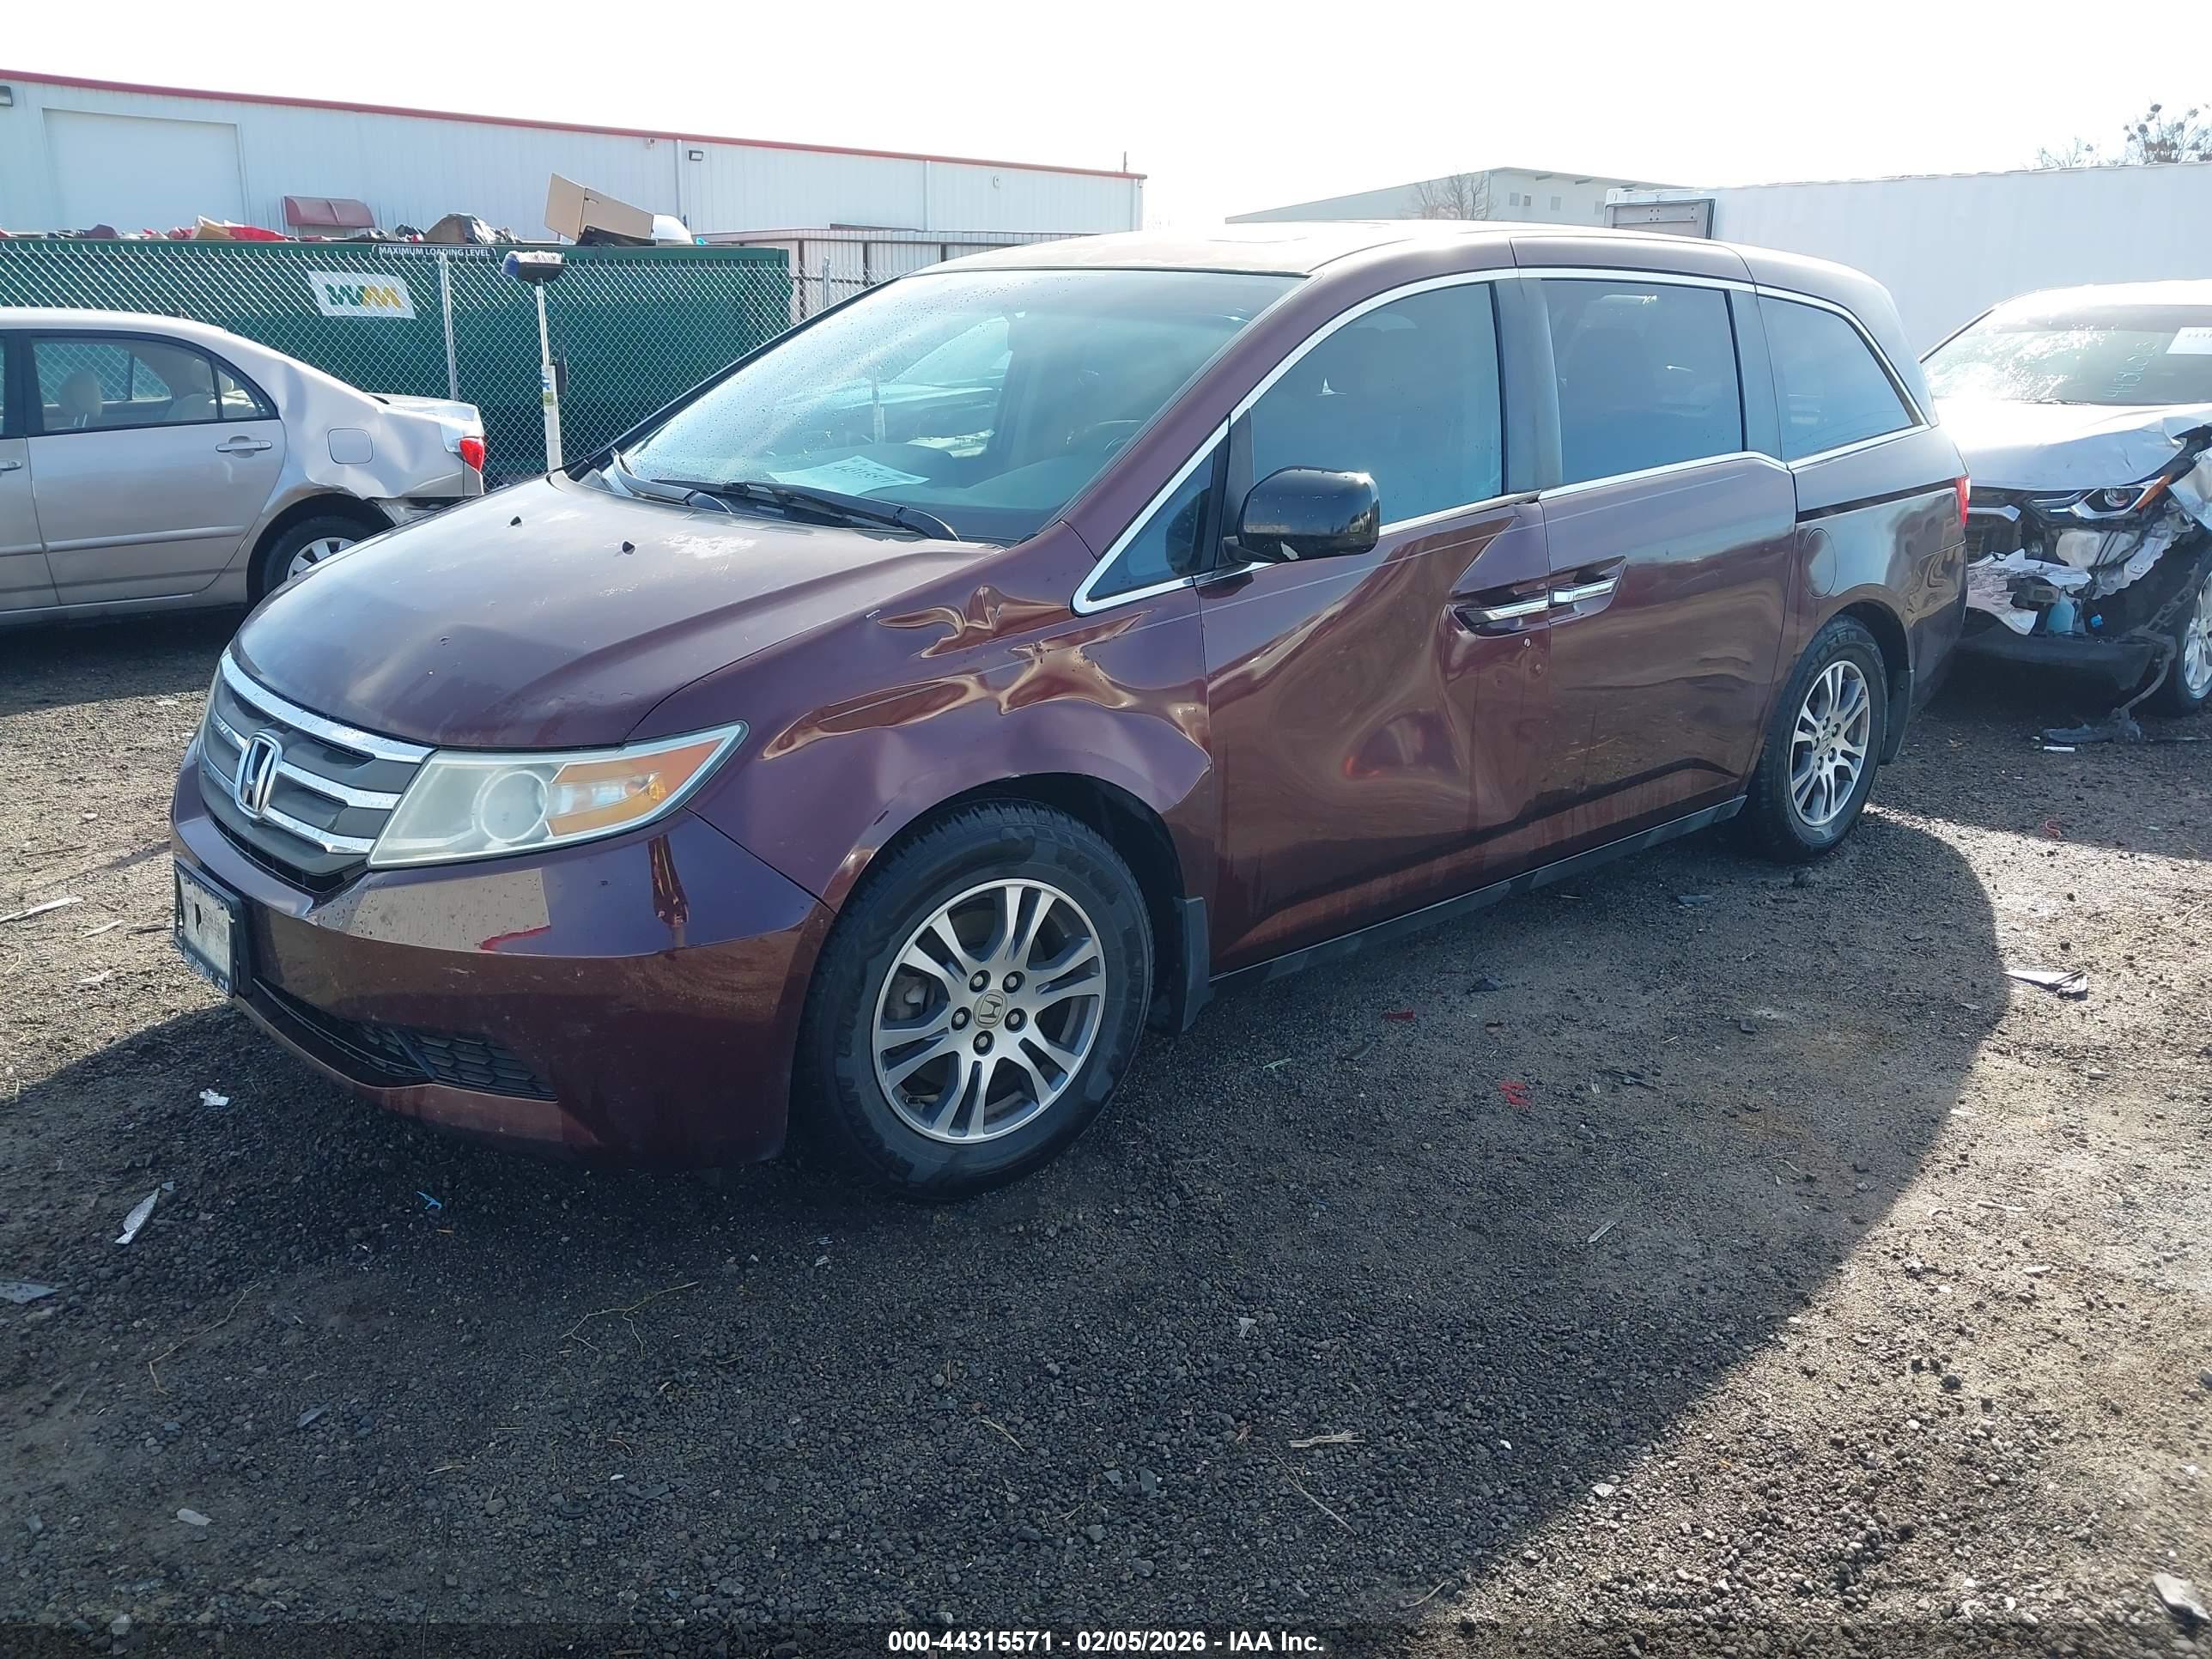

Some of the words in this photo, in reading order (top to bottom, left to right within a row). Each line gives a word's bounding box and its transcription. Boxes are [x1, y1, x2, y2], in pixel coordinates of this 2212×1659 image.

[378, 246, 424, 256] MAXIMUM
[425, 248, 465, 257] LOADING
[465, 248, 490, 257] LEVEL
[325, 283, 400, 308] WM
